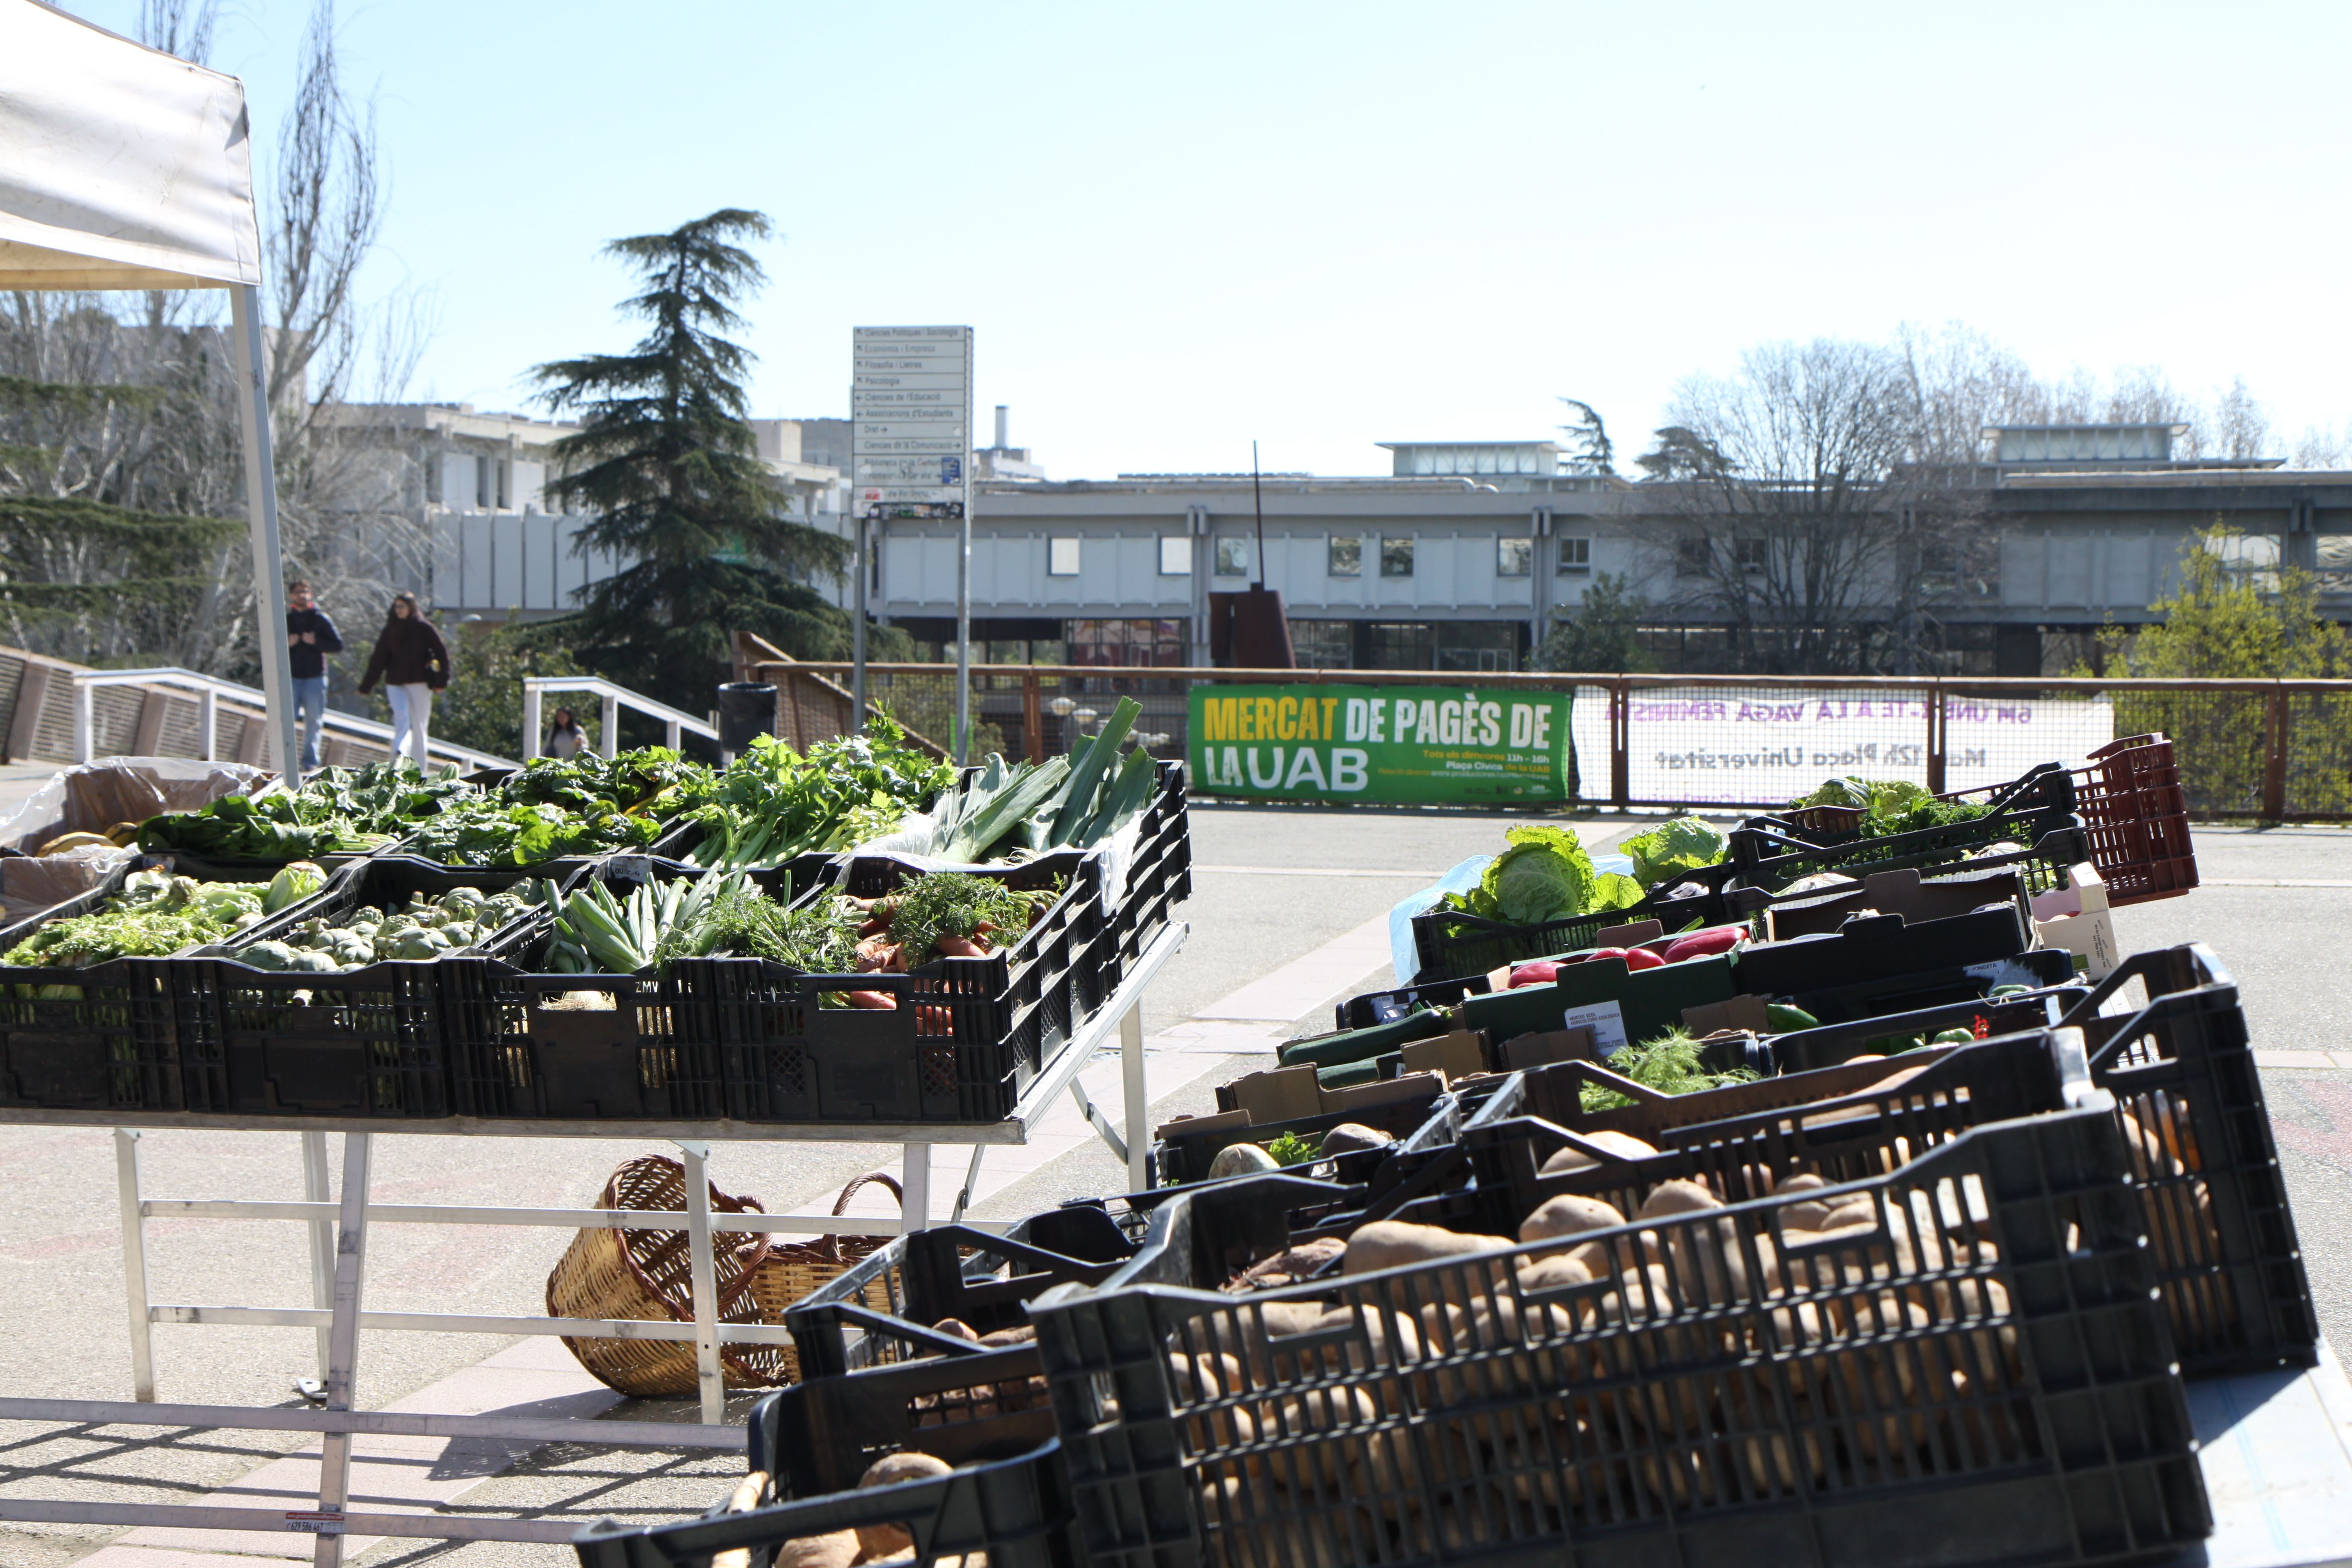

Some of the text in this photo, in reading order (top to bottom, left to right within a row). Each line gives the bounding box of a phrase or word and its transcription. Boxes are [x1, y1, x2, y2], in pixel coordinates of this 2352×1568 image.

[1204, 693, 1552, 749] MERCAT DE PAGÈS DE
[1423, 749, 1444, 759] Tots
[1446, 750, 1460, 759] els
[1462, 750, 1505, 761] dimecres
[1507, 753, 1523, 763] 11h
[1531, 754, 1550, 764] 16h
[1246, 746, 1369, 791] UAB
[1446, 761, 1473, 771] Plaça
[1529, 764, 1551, 774] UAB
[1570, 1017, 1598, 1026] AGRICULTURA
[290, 1521, 324, 1532] 629 586 467
